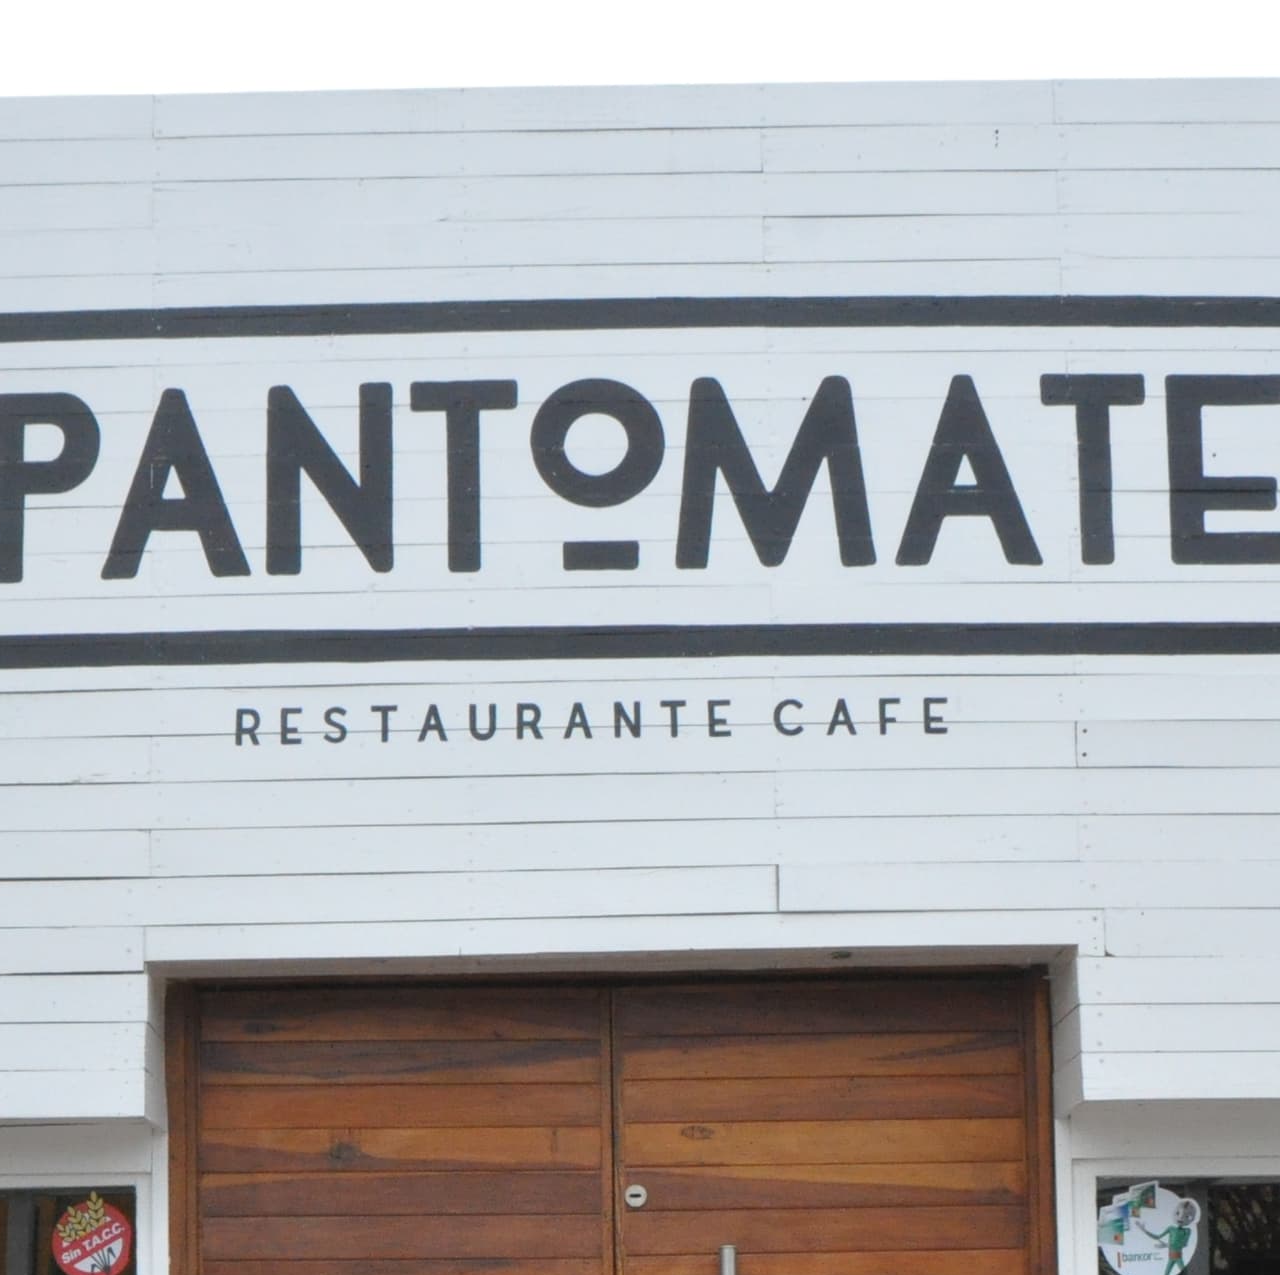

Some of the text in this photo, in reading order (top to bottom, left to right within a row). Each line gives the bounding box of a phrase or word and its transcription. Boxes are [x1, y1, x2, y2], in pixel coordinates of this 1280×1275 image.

[234, 696, 949, 747] RESTAURANTE CAFE
[61, 1248, 82, 1264] Sin
